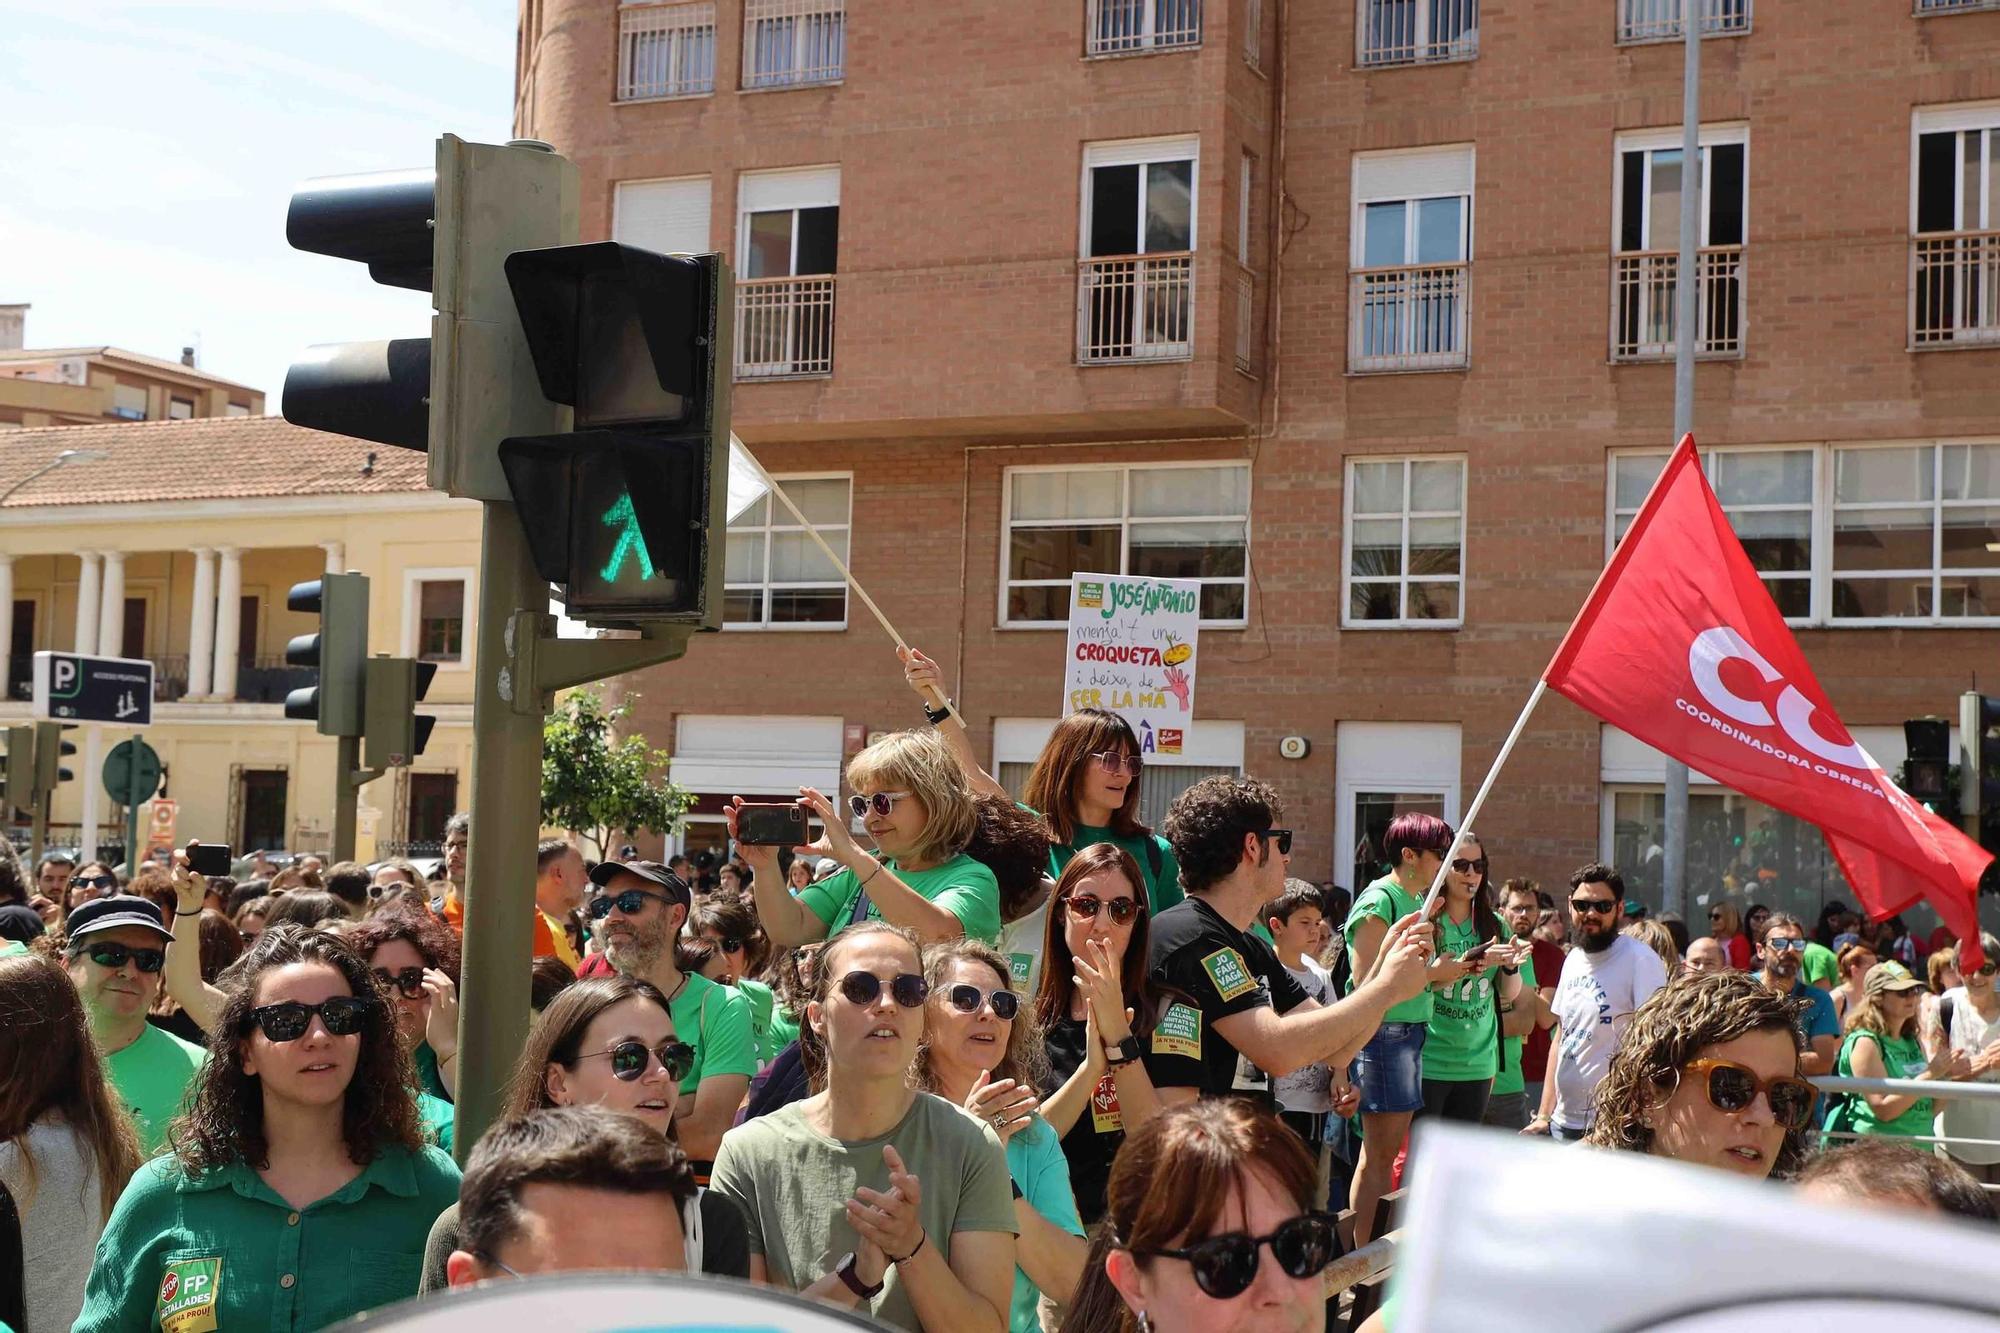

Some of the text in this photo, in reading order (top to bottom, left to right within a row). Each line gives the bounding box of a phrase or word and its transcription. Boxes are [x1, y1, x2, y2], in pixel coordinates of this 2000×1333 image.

[1140, 581, 1196, 616] ANTONIO
[1076, 642, 1163, 667] CROQUETA
[55, 660, 76, 690] P
[1070, 687, 1103, 712] FER
[1111, 689, 1133, 709] LA
[1675, 698, 1885, 799] COORDINADORA OBRERA
[1214, 961, 1237, 977] FAIG
[1215, 954, 1228, 966] JO
[1216, 969, 1244, 986] VAGA
[161, 1275, 208, 1298] STOP FP
